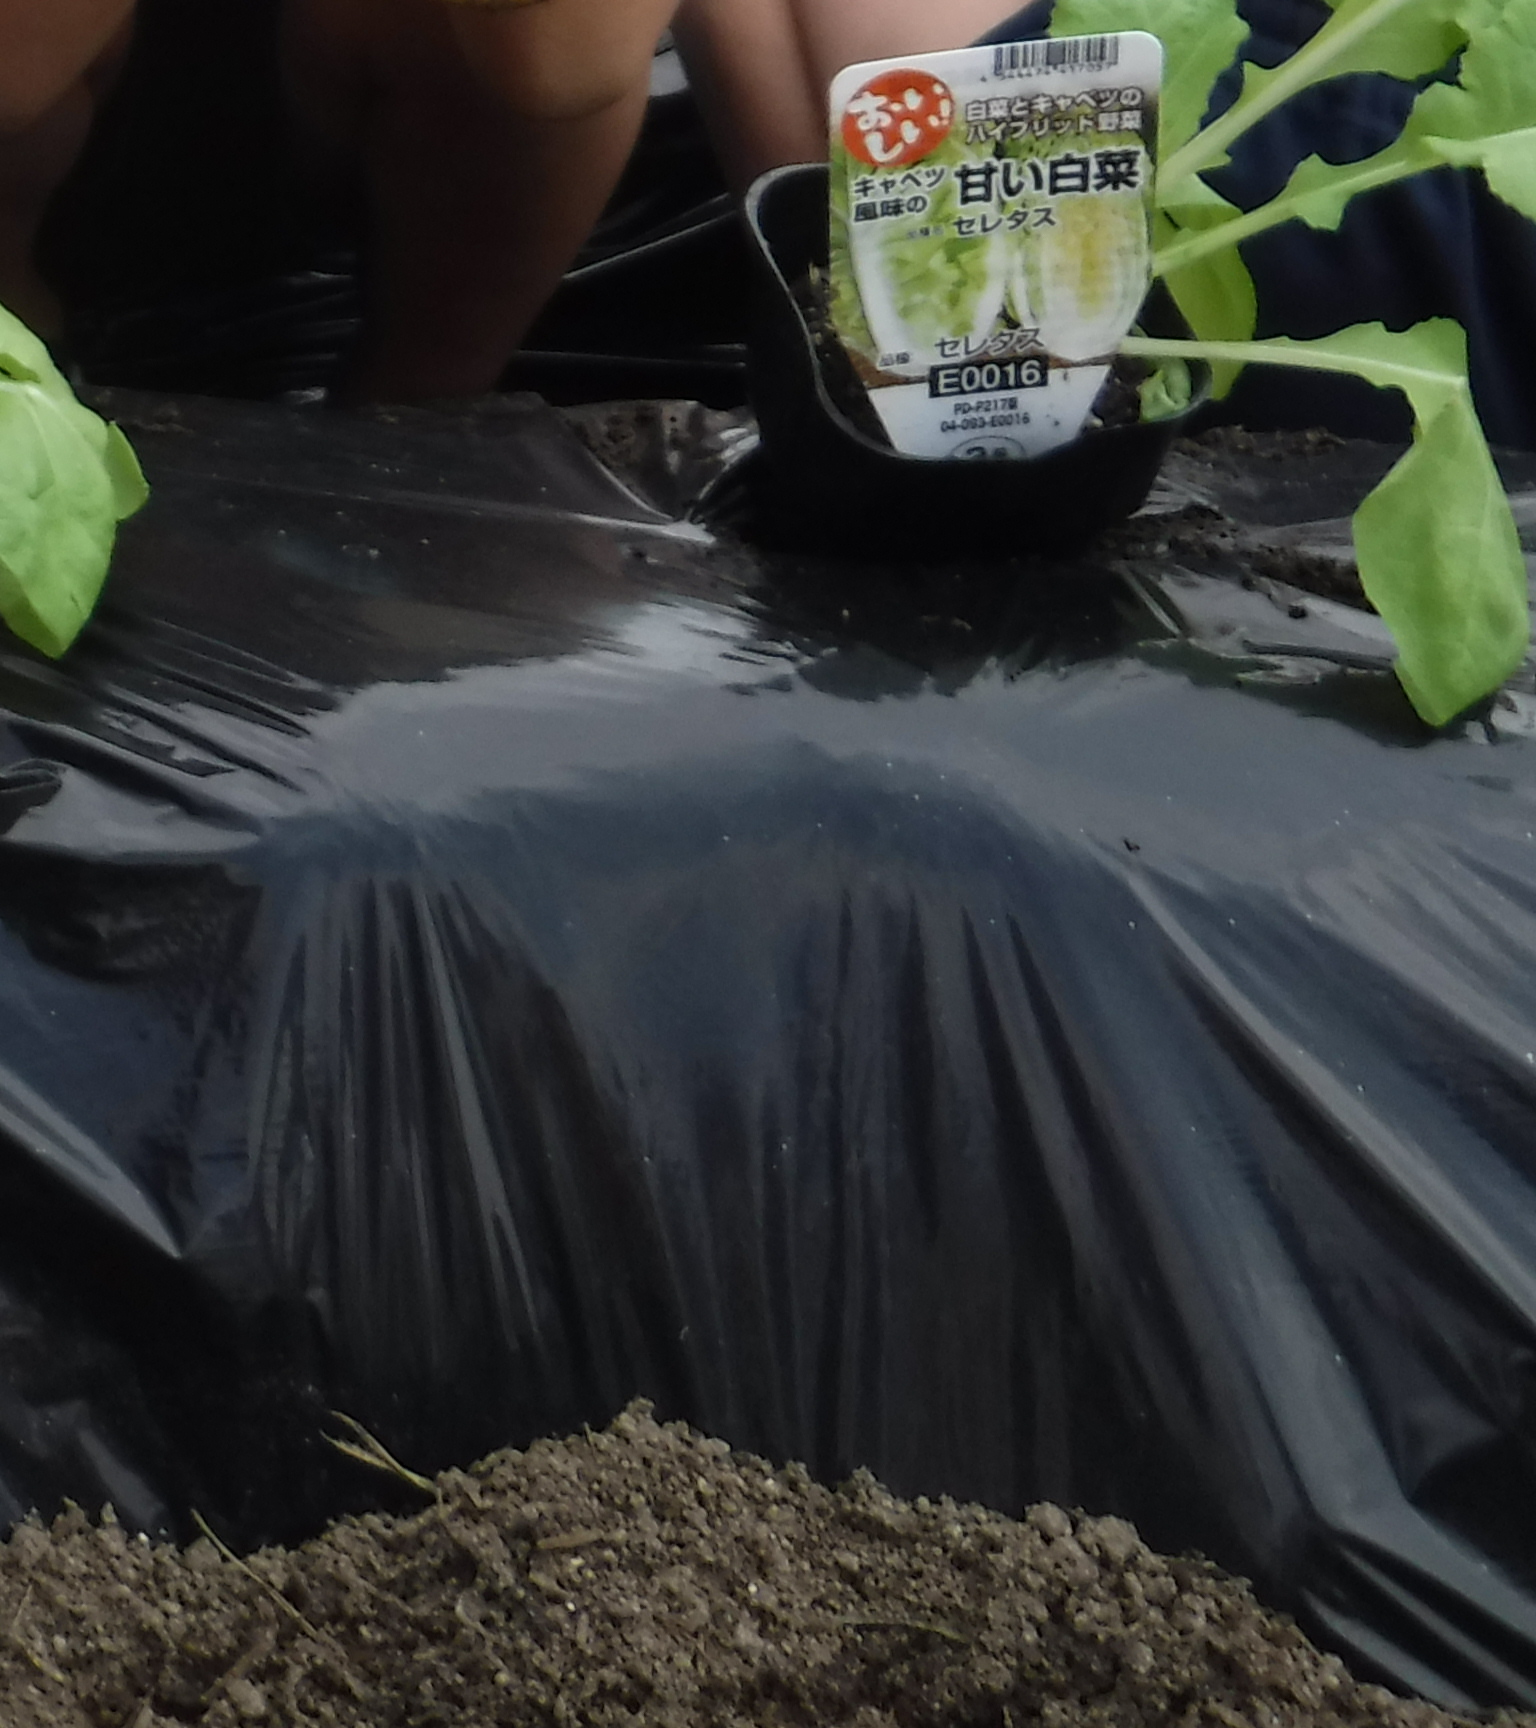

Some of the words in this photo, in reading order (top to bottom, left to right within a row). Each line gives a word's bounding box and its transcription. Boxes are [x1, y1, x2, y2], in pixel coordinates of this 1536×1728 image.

[966, 87, 1143, 121] 白菜とキャベツの
[854, 166, 945, 198] キャベツ
[954, 150, 1140, 205] 甘い白菜
[853, 195, 928, 223] 風味の
[954, 207, 1056, 236] セレタス
[935, 328, 1044, 359] セレタス
[938, 360, 1042, 394] E0016
